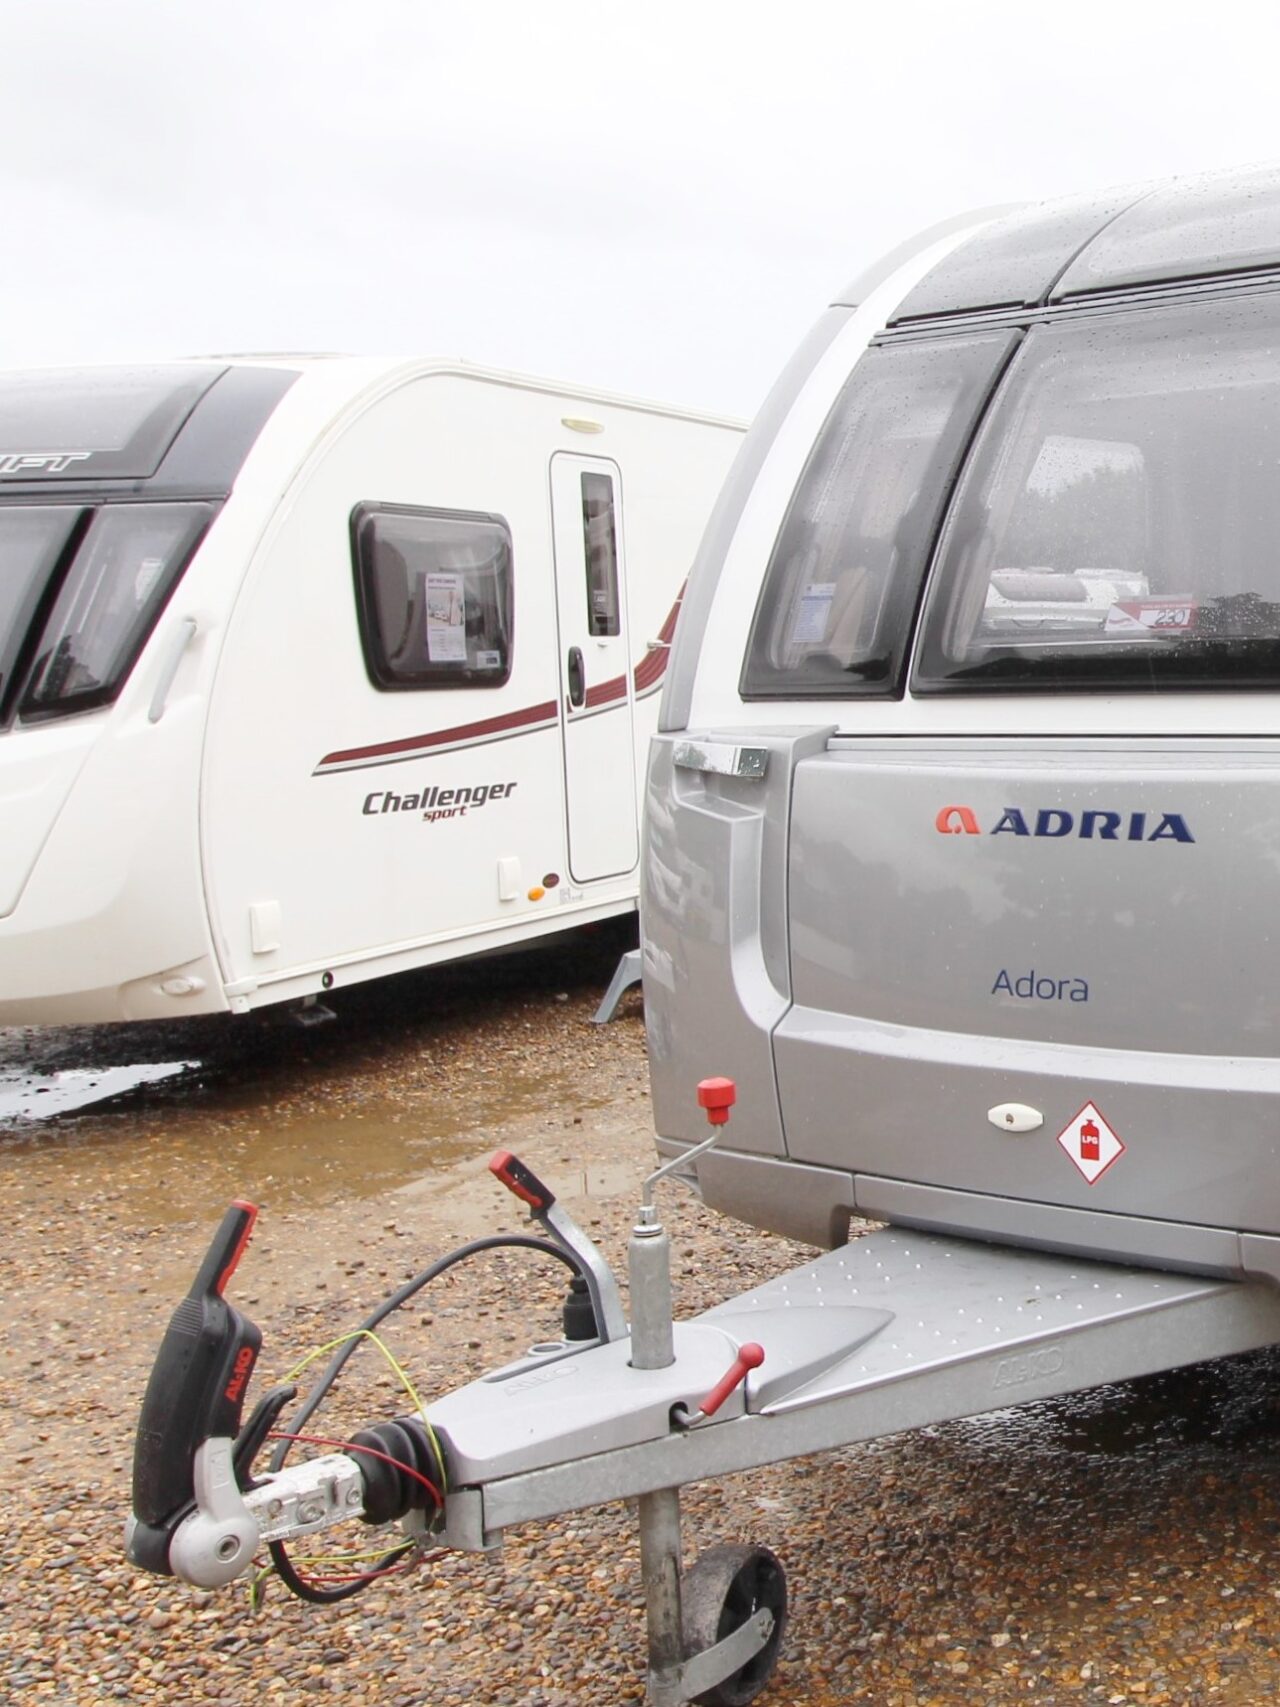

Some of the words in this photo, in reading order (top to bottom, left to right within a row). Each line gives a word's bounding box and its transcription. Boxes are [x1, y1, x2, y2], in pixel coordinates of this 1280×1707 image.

[362, 782, 517, 816] Challenger
[422, 805, 467, 823] sport
[990, 807, 1196, 843] ADRIA
[991, 969, 1089, 1002] Adora
